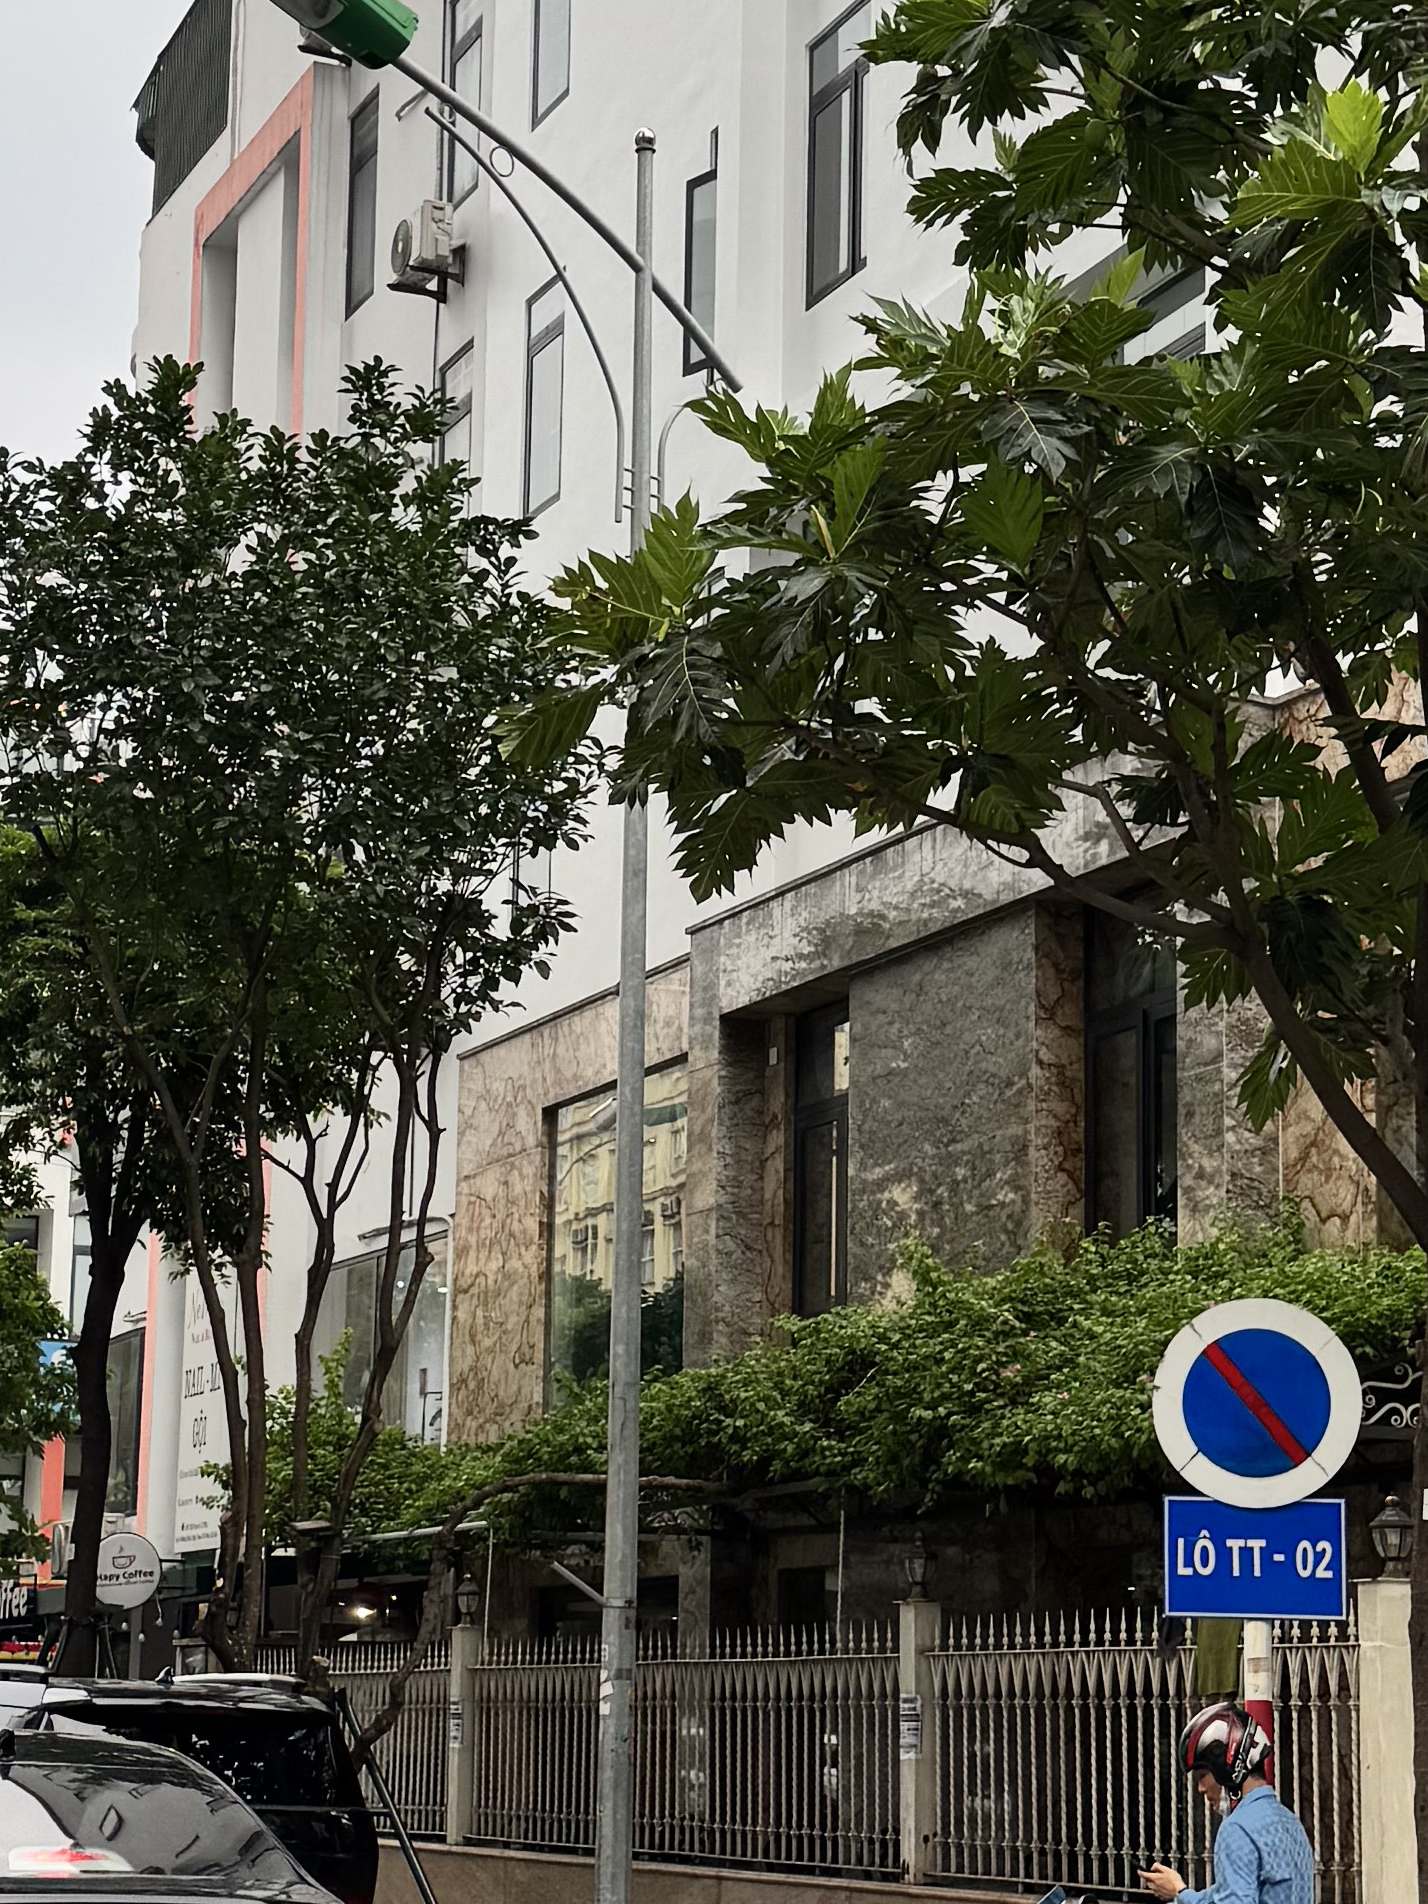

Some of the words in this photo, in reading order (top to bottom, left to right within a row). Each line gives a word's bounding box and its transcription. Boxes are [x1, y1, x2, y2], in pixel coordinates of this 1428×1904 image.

[1177, 1529, 1216, 1576] LÔ
[1225, 1538, 1267, 1577] TT
[1295, 1539, 1334, 1579] 02
[122, 1569, 154, 1580] Coffee
